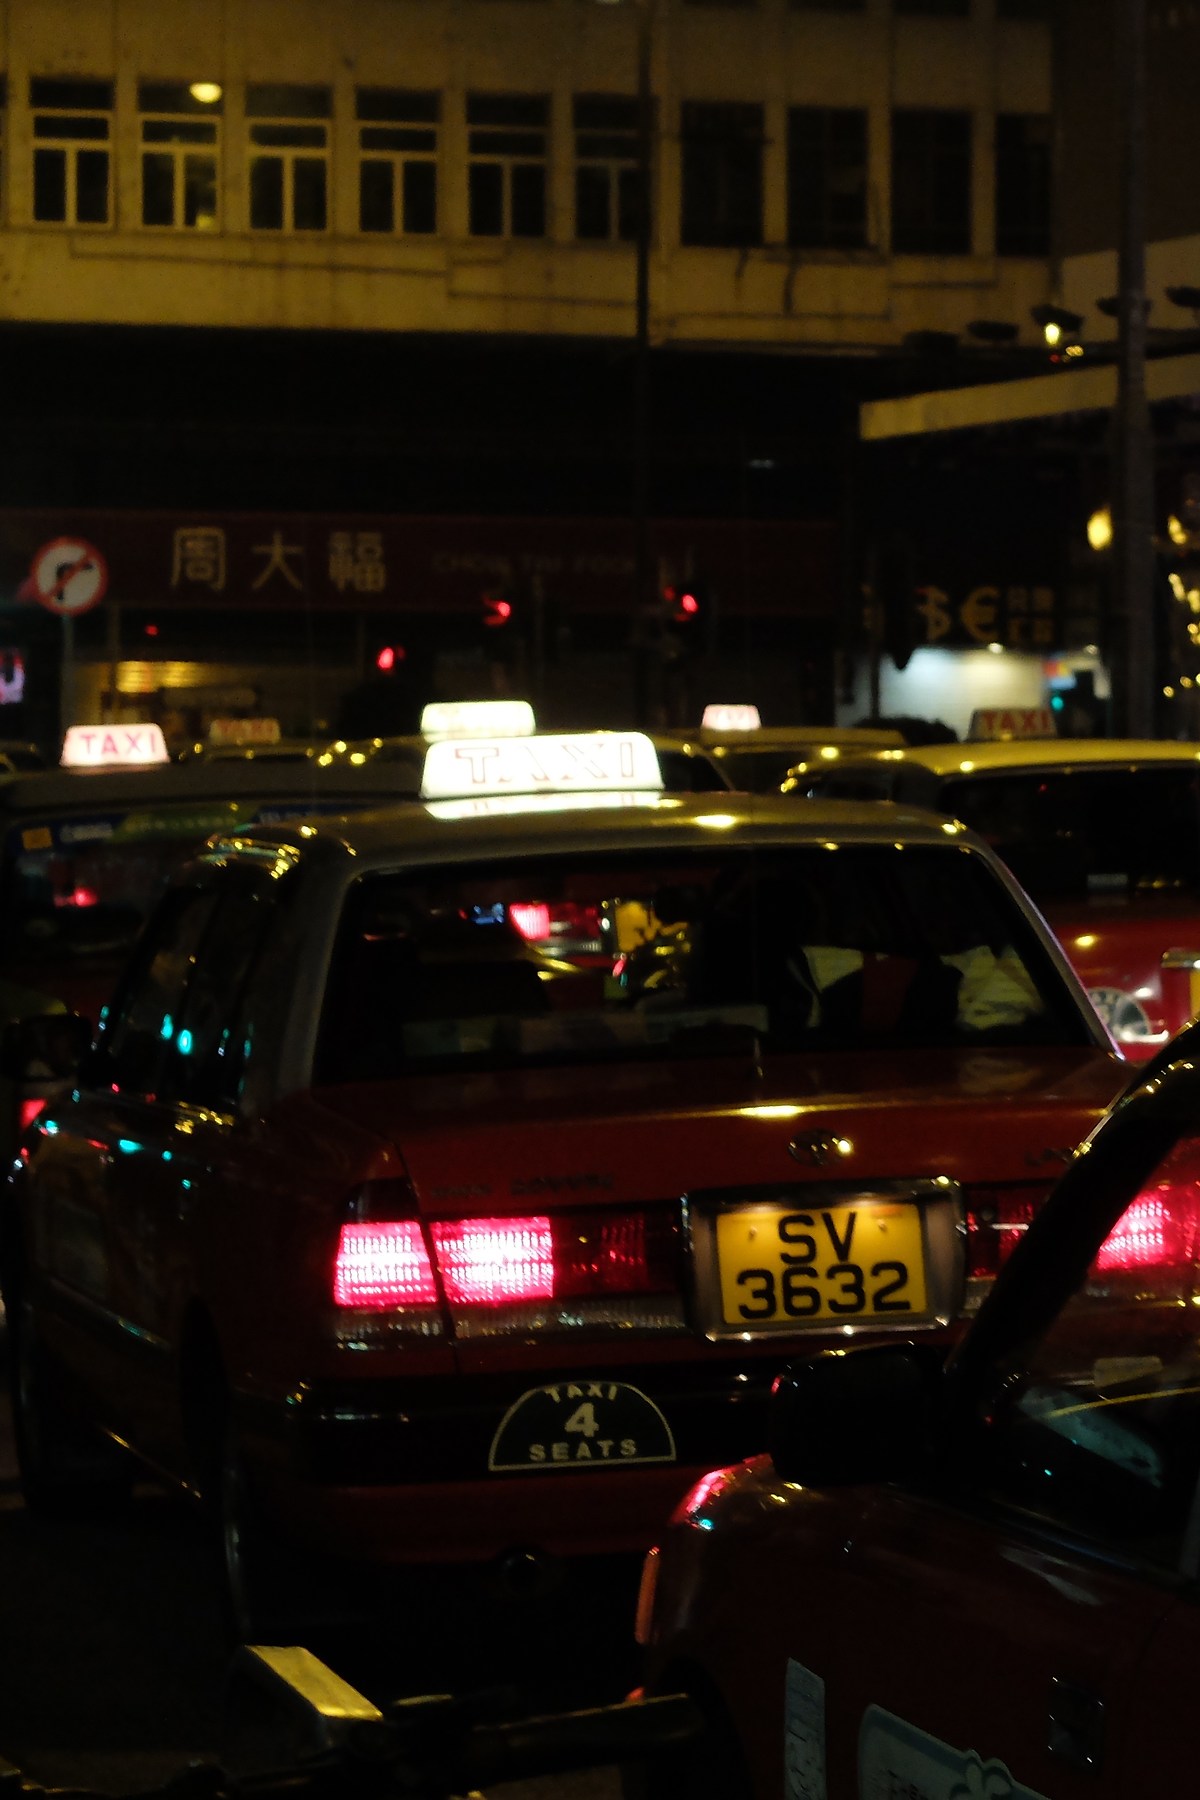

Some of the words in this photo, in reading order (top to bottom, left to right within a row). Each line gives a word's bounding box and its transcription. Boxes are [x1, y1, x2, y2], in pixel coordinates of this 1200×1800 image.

[170, 525, 389, 593] 周大福
[981, 710, 1050, 731] TAXI
[80, 734, 156, 755] TAXI
[455, 742, 636, 785] TAXI
[778, 1212, 856, 1264] SV
[737, 1262, 911, 1319] 3632
[543, 1384, 618, 1404] TAXI
[564, 1402, 600, 1438] 4
[529, 1439, 637, 1462] SEATS
